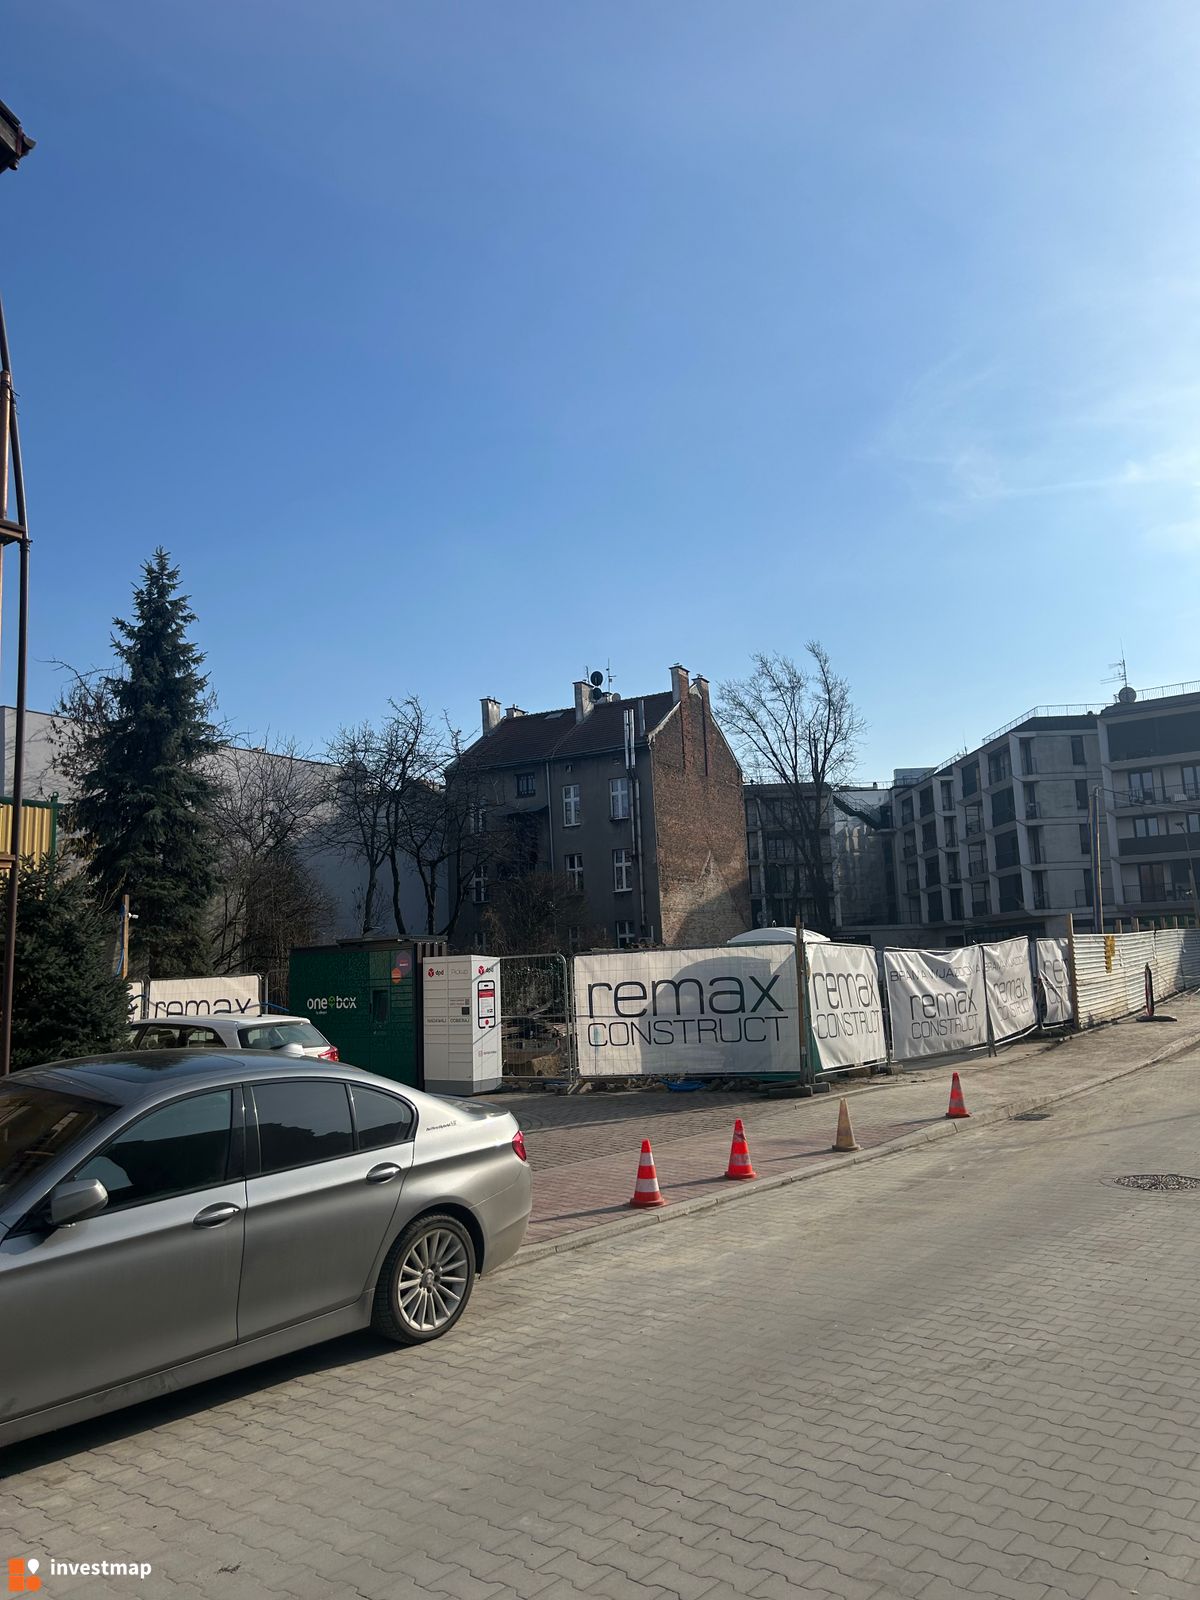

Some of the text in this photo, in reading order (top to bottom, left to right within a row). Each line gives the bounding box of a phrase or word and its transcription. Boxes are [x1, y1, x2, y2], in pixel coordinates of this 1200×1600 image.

[307, 996, 357, 1010] one box
[588, 974, 784, 1018] remax
[812, 972, 878, 1010] remax
[910, 989, 978, 1020] remax
[994, 977, 1027, 1005] remax
[588, 1016, 789, 1047] CONSTRUCT
[816, 1010, 880, 1039] CONSTRUCT
[911, 1014, 978, 1039] CONSTRUCT
